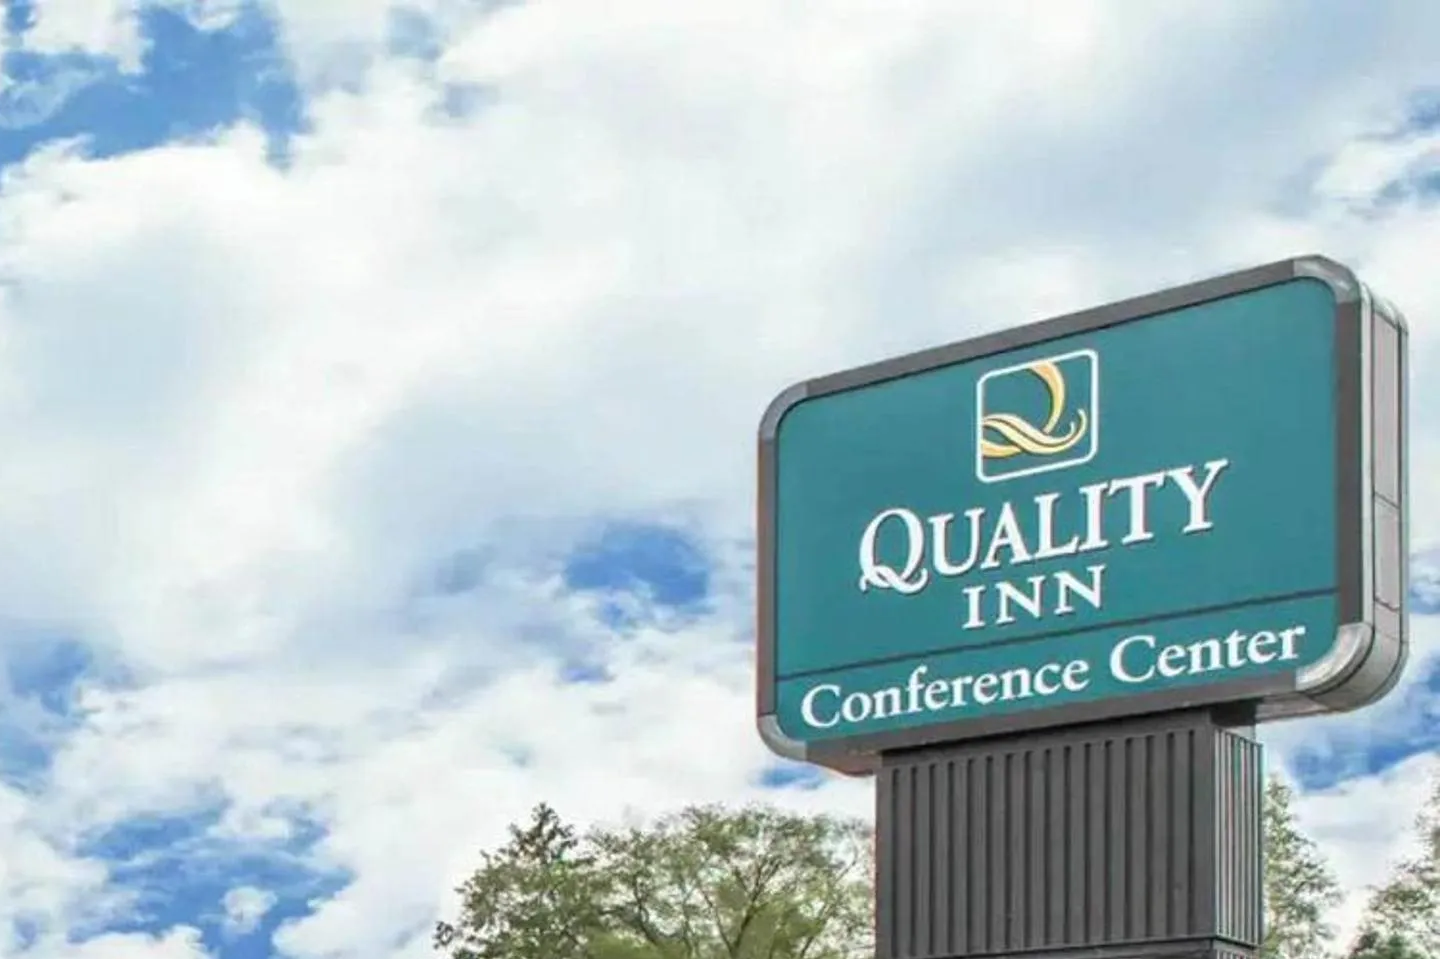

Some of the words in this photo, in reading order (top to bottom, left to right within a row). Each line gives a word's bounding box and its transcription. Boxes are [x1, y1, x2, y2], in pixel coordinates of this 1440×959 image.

[858, 458, 1229, 594] QUALITY
[963, 564, 1105, 630] INN
[801, 659, 1090, 728] Conference
[1109, 625, 1307, 684] Center
